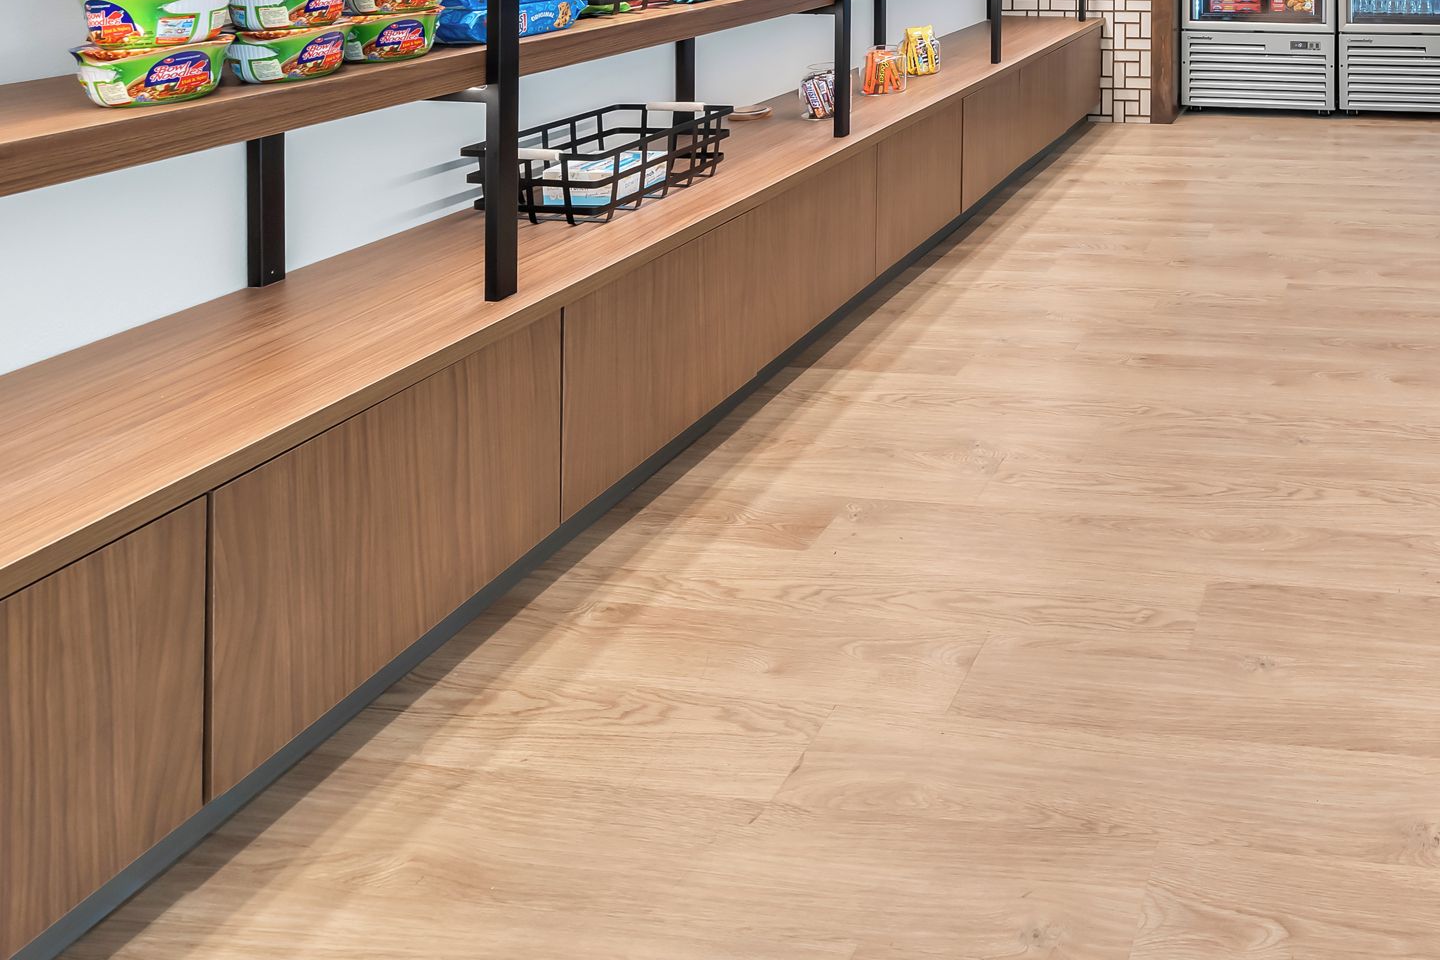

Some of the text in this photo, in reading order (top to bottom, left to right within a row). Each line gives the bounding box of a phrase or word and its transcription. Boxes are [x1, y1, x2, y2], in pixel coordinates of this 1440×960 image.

[532, 12, 554, 22] ORIGINAL
[383, 28, 411, 37] Bowl
[380, 33, 421, 43] Noodles
[154, 61, 190, 74] Bowl
[150, 67, 205, 82] Noodles
